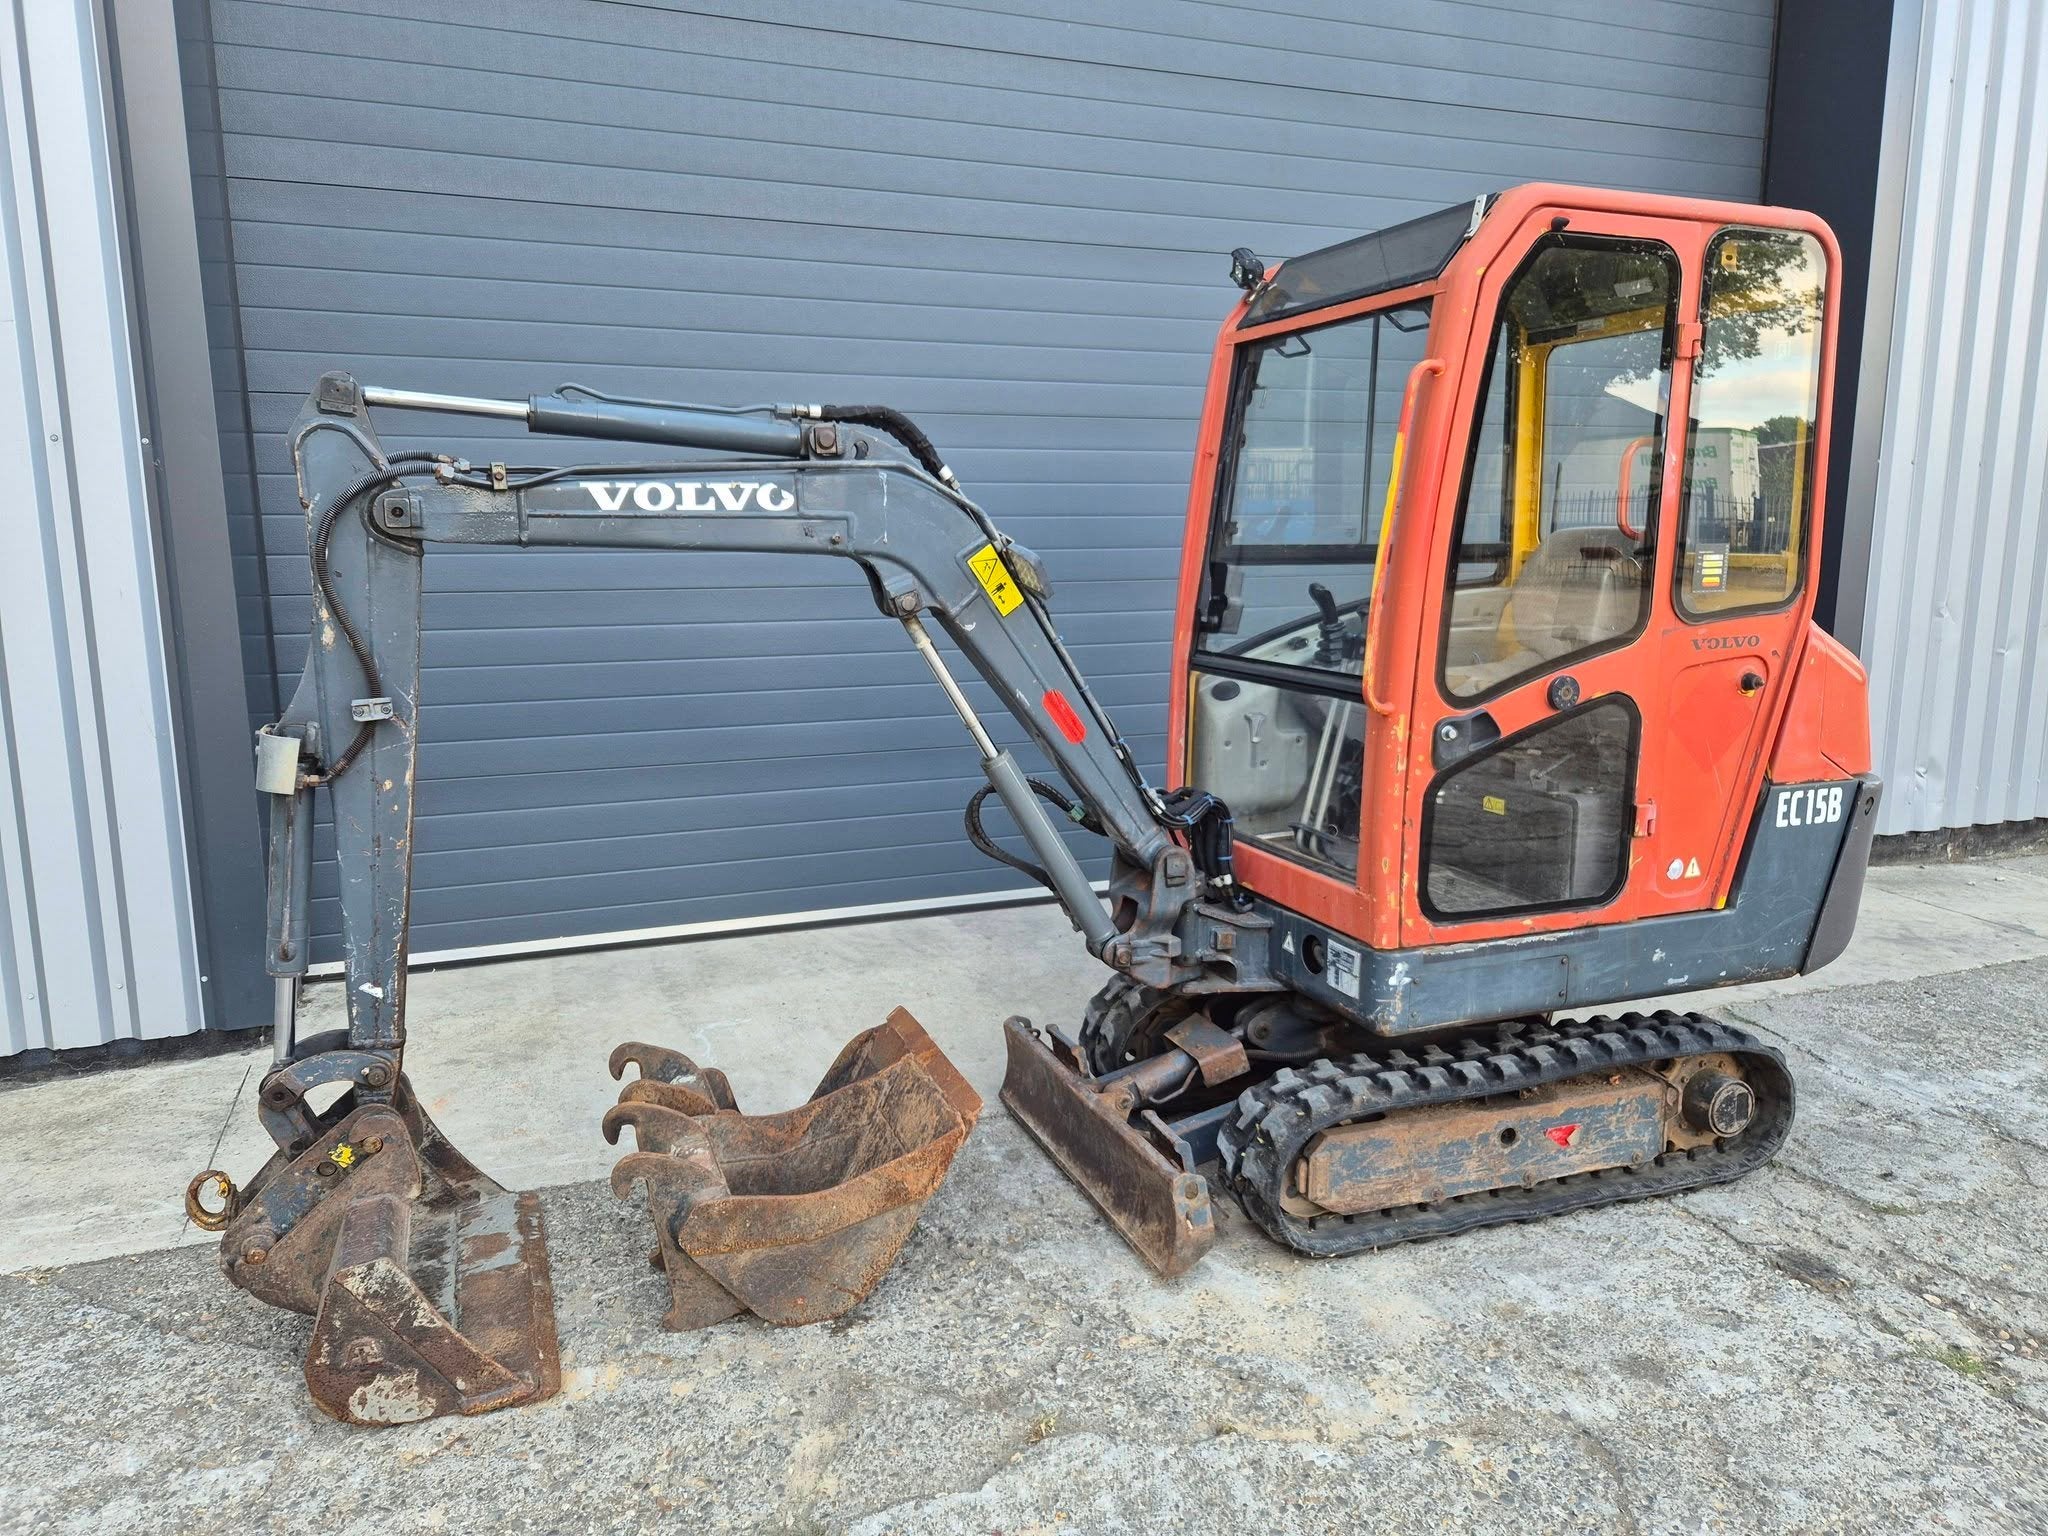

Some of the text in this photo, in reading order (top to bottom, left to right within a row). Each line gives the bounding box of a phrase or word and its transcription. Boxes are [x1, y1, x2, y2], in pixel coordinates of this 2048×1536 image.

[580, 481, 794, 511] VOLVO
[1692, 635, 1760, 650] VOLVO
[1775, 787, 1843, 828] EC15B
